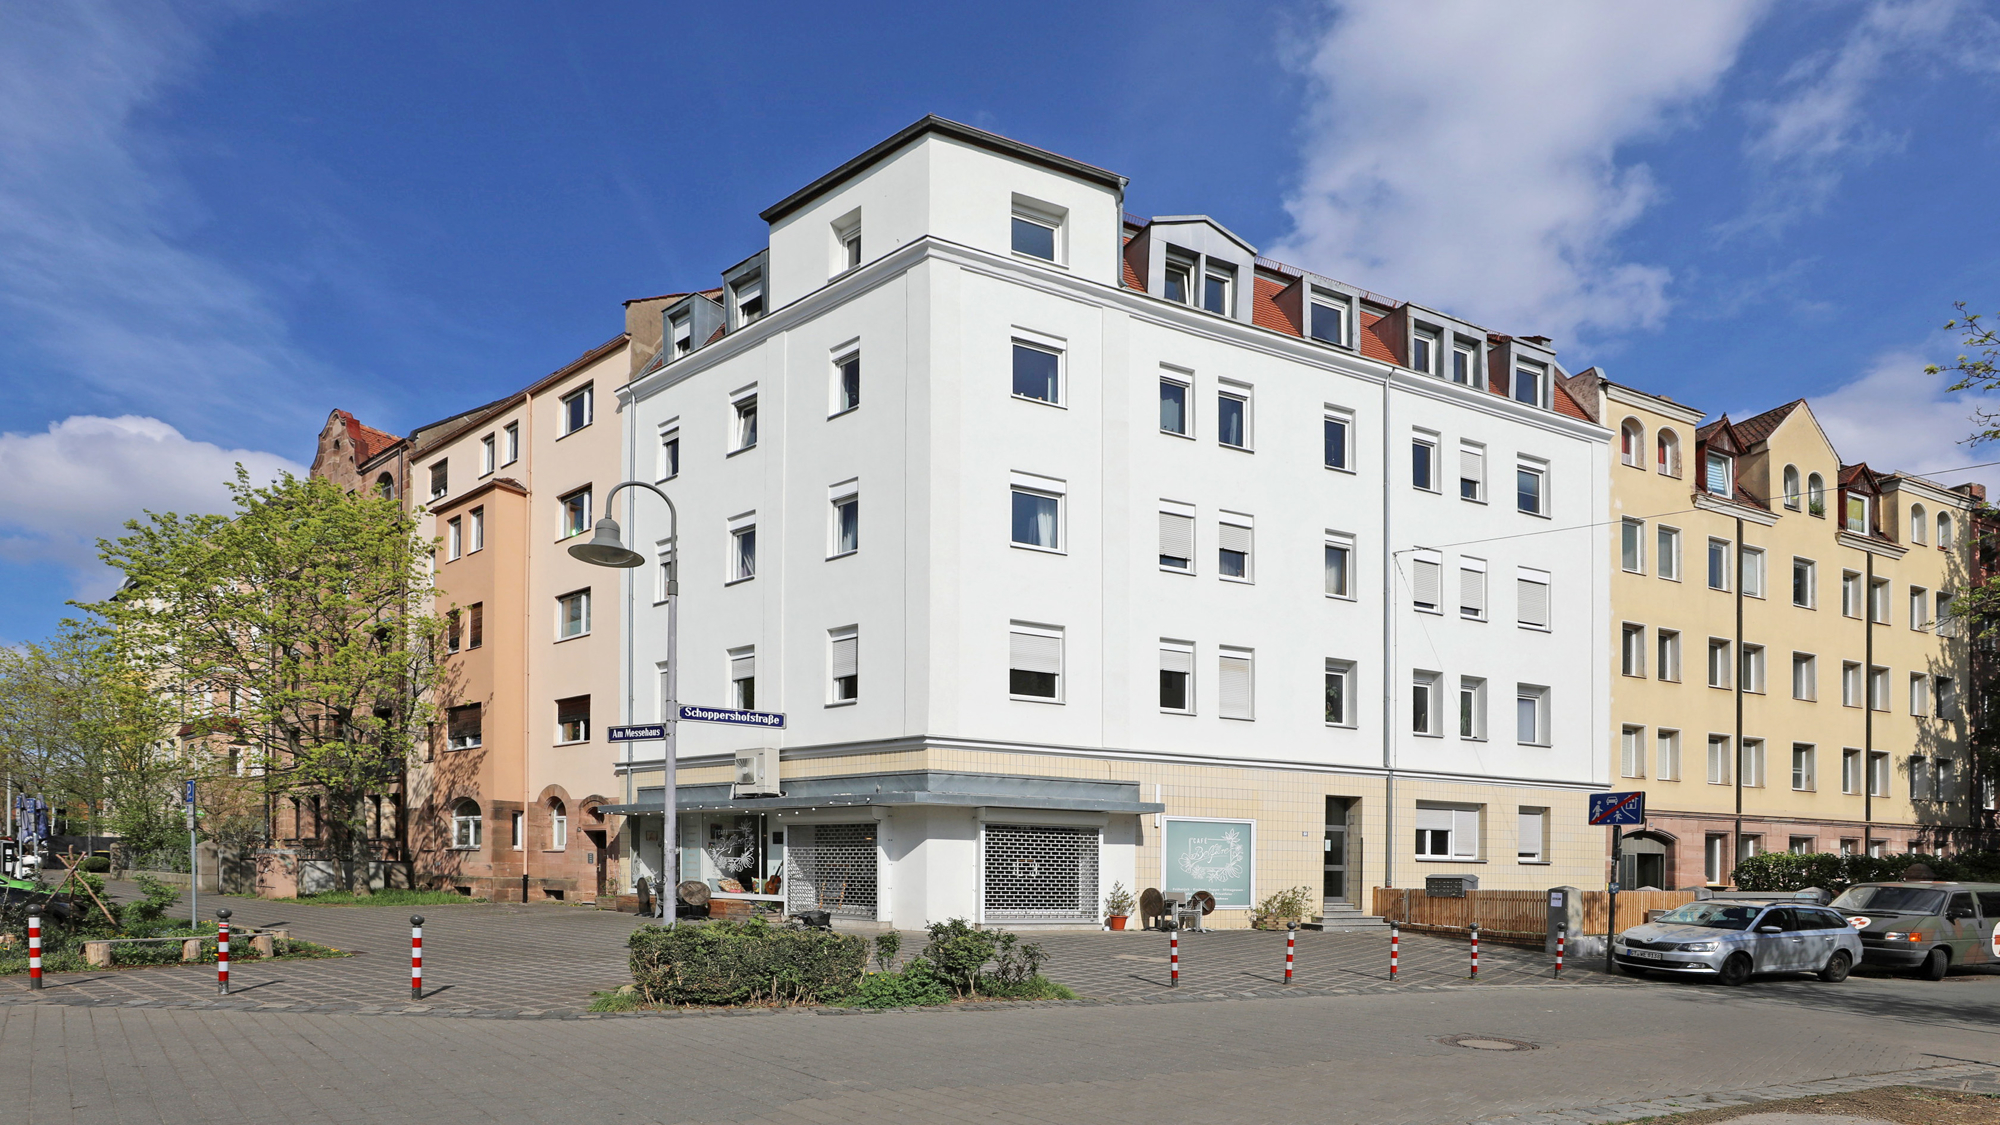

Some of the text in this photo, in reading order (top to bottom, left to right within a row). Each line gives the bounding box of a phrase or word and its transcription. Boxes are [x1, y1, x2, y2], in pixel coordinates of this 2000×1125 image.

[684, 707, 780, 725] Schoppershofstraße
[612, 727, 661, 738] Am Messehaus
